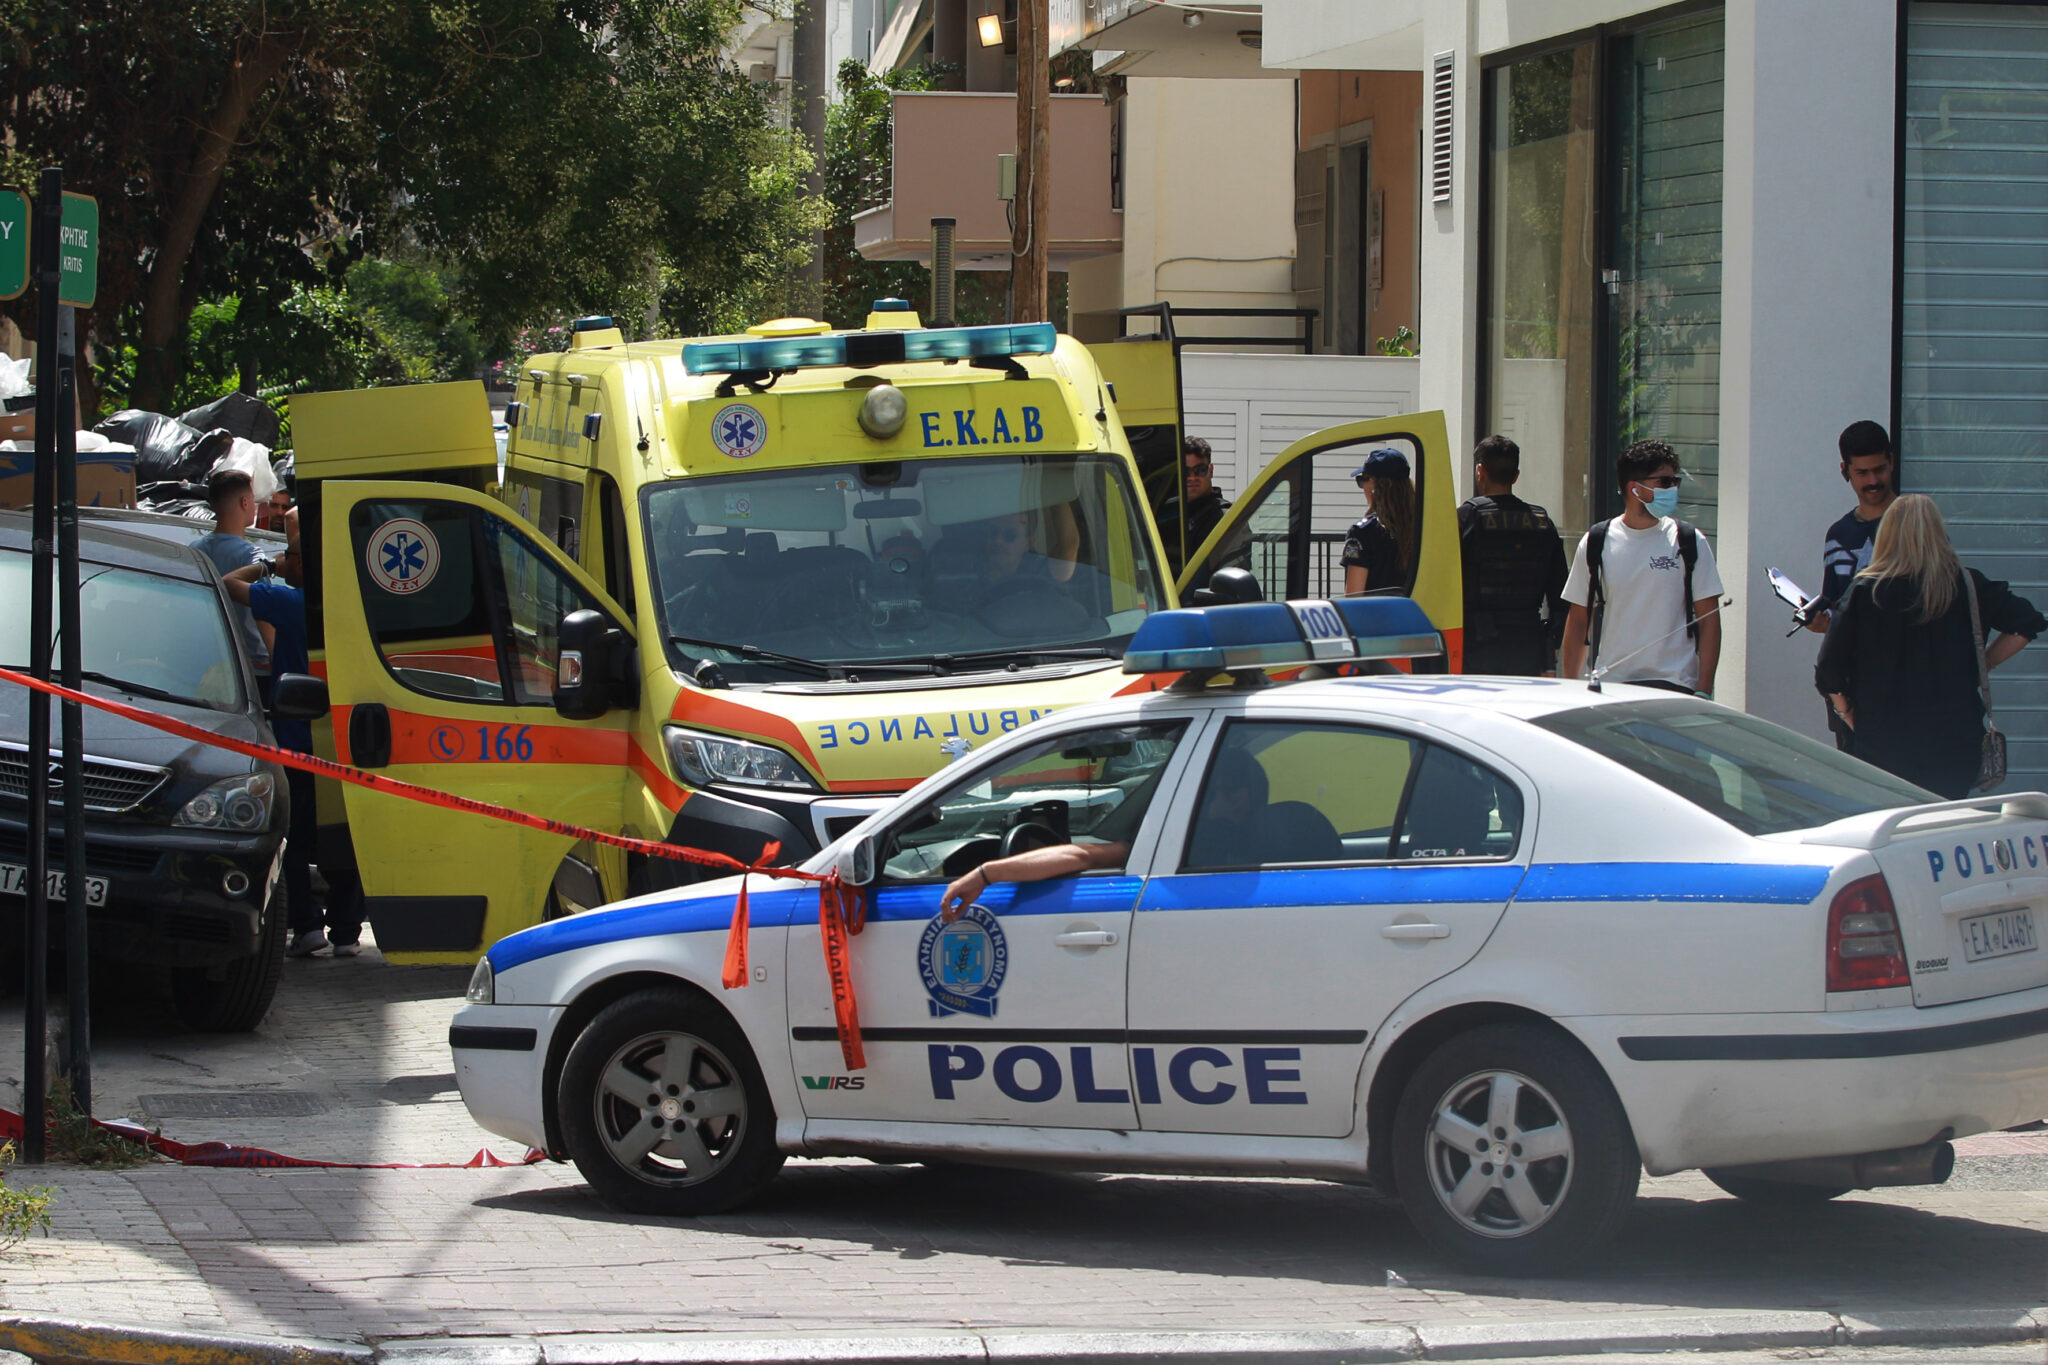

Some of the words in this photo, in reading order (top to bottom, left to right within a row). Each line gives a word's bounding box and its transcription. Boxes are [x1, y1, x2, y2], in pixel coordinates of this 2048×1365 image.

[60, 226, 88, 248] ΚΡΗΤΗΣ
[63, 256, 83, 273] KRITIS
[1299, 606, 1343, 639] 100
[477, 725, 534, 761] 166
[920, 916, 949, 989] ΕΛΛΗΝΙΚ
[965, 908, 1006, 989] ΑΣΤΥΝΟΜΙΑ
[927, 1044, 1309, 1105] POLICE
